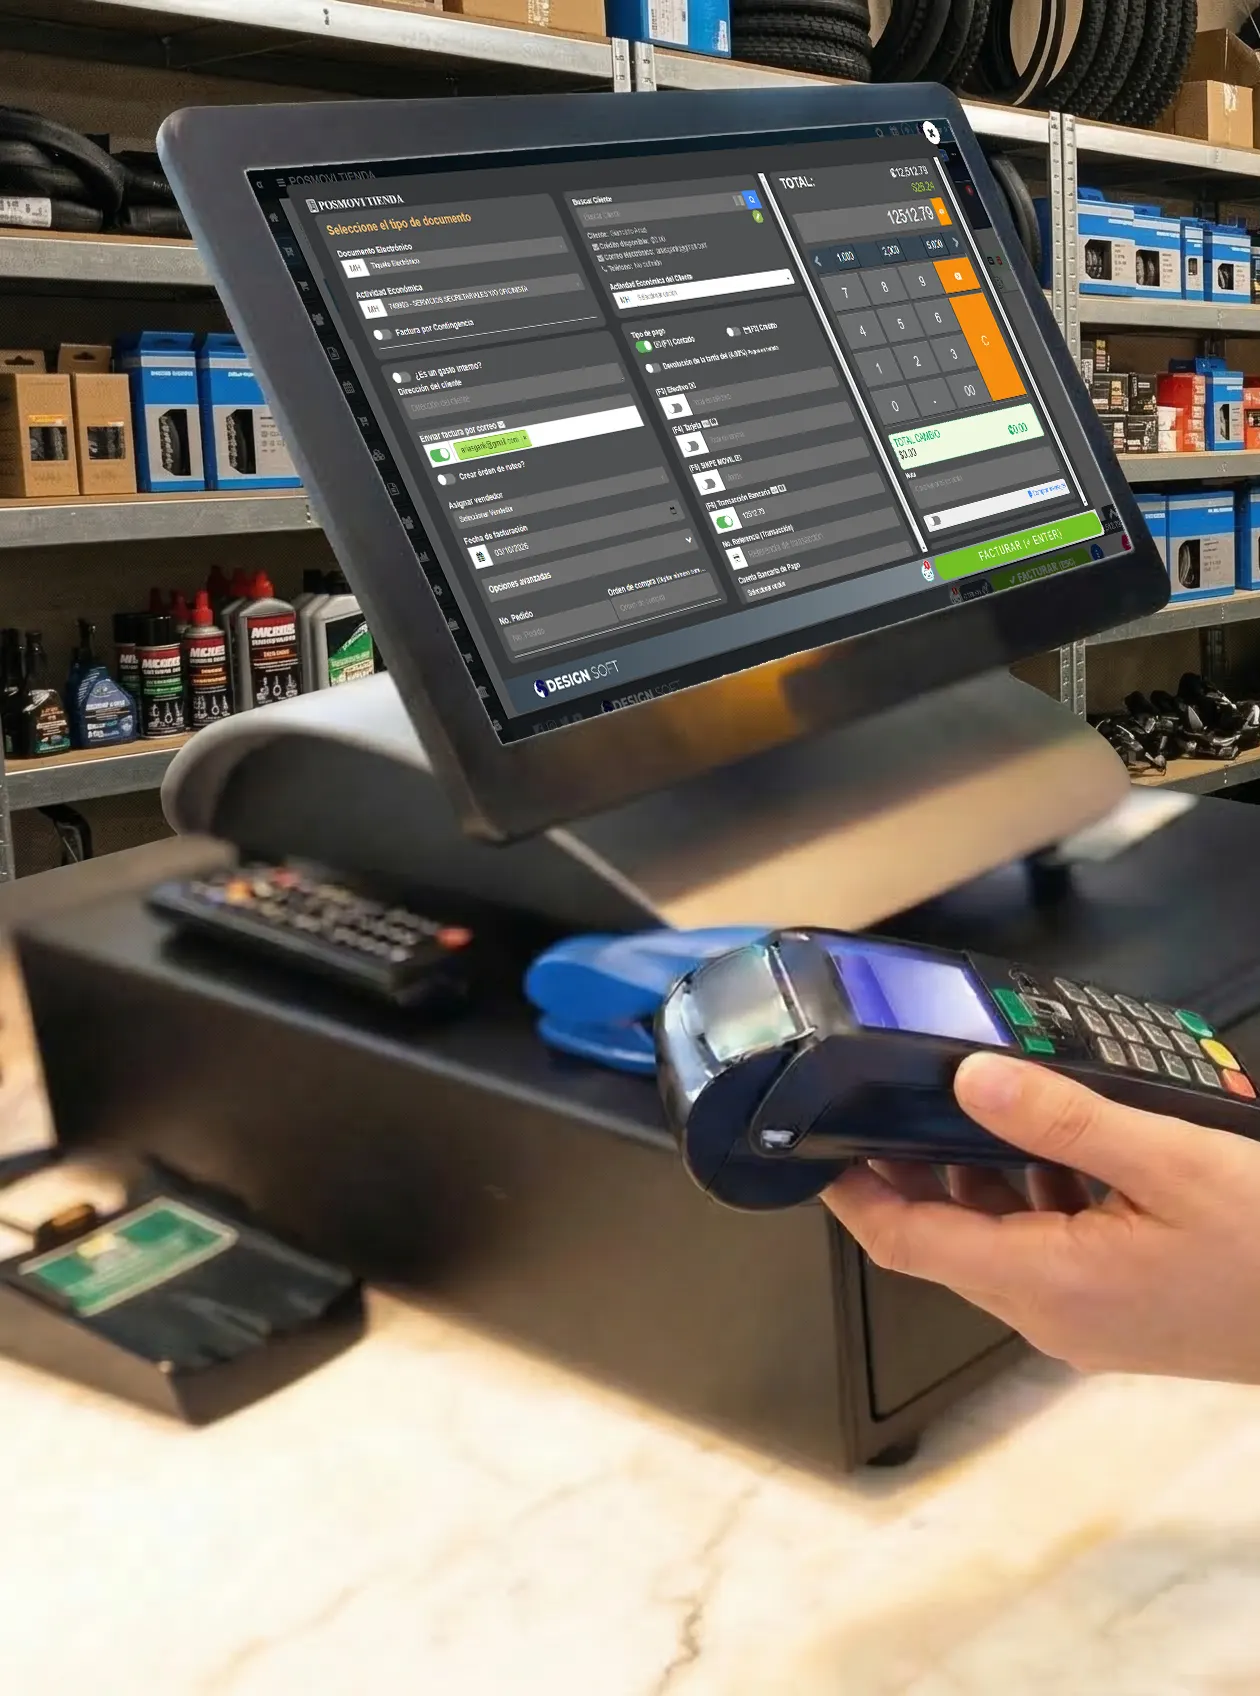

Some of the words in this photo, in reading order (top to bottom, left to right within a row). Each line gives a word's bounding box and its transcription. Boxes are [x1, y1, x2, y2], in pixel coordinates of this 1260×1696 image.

[779, 176, 815, 189] TOTAL:
[318, 198, 365, 210] POSMOVI
[365, 195, 404, 206] TIENDA
[572, 197, 591, 206] Buscar
[592, 195, 612, 204] Cliente
[888, 206, 934, 224] 12512.79
[327, 222, 378, 235] Seleccione
[380, 220, 389, 230] el
[389, 219, 408, 231] tipo
[410, 217, 421, 227] de
[423, 213, 471, 226] documento
[337, 248, 375, 257] Documento
[375, 244, 412, 253] Electrónico
[610, 280, 635, 291] Actividad
[635, 278, 665, 287] Económica
[675, 272, 693, 282] Cliente
[881, 281, 889, 293] 8
[918, 275, 926, 287] 9
[356, 289, 387, 298] Actividad
[387, 285, 423, 295] Económica
[841, 287, 849, 298] 7
[897, 318, 905, 330] 5
[934, 312, 943, 324] 6
[395, 328, 420, 336] Factura
[421, 326, 432, 334] por
[433, 320, 474, 330] Contingencia
[642, 329, 652, 338] de
[651, 329, 666, 337] pago
[859, 325, 867, 337] 4
[672, 336, 695, 345] Contado
[981, 335, 990, 346] C
[950, 349, 959, 360] 3
[662, 359, 693, 369] Devolución
[691, 356, 701, 365] de
[913, 356, 922, 367] 2
[416, 371, 428, 381] ¿Es
[438, 367, 456, 377] gasto
[456, 362, 482, 372] interno?
[876, 363, 883, 374] 1
[398, 385, 429, 395] Dirección
[441, 380, 462, 388] cliente
[964, 384, 976, 397] 00
[892, 401, 900, 412] 0
[420, 433, 440, 442] Enviar
[441, 429, 464, 438] factura
[465, 427, 475, 436] por
[476, 423, 497, 432] correo
[893, 436, 916, 447] TOTAL
[915, 430, 940, 442] CAMBIO
[459, 472, 476, 480] Crear
[478, 468, 496, 476] órden
[505, 461, 525, 470] ruteo?
[449, 499, 473, 509] Asignar
[474, 493, 503, 503] vendedor
[716, 494, 748, 506] Transacción
[748, 489, 770, 499] Bancaria
[463, 536, 484, 545] Fecha
[493, 526, 528, 538] facturación
[494, 543, 529, 556] 03/10/2026
[978, 541, 1022, 561] FACTURAR
[1032, 529, 1062, 545] ENTER)
[738, 574, 757, 584] Cuenta
[757, 568, 780, 579] Bancaria
[1017, 562, 1058, 581] FACTURAR
[489, 581, 519, 593] Opciones
[520, 572, 551, 585] avanzadas
[608, 587, 626, 596] Orden
[634, 579, 656, 589] compra
[499, 617, 511, 625] No.
[511, 611, 533, 621] Pedido
[546, 669, 591, 692] DESIGN
[591, 660, 618, 679] SOFT
